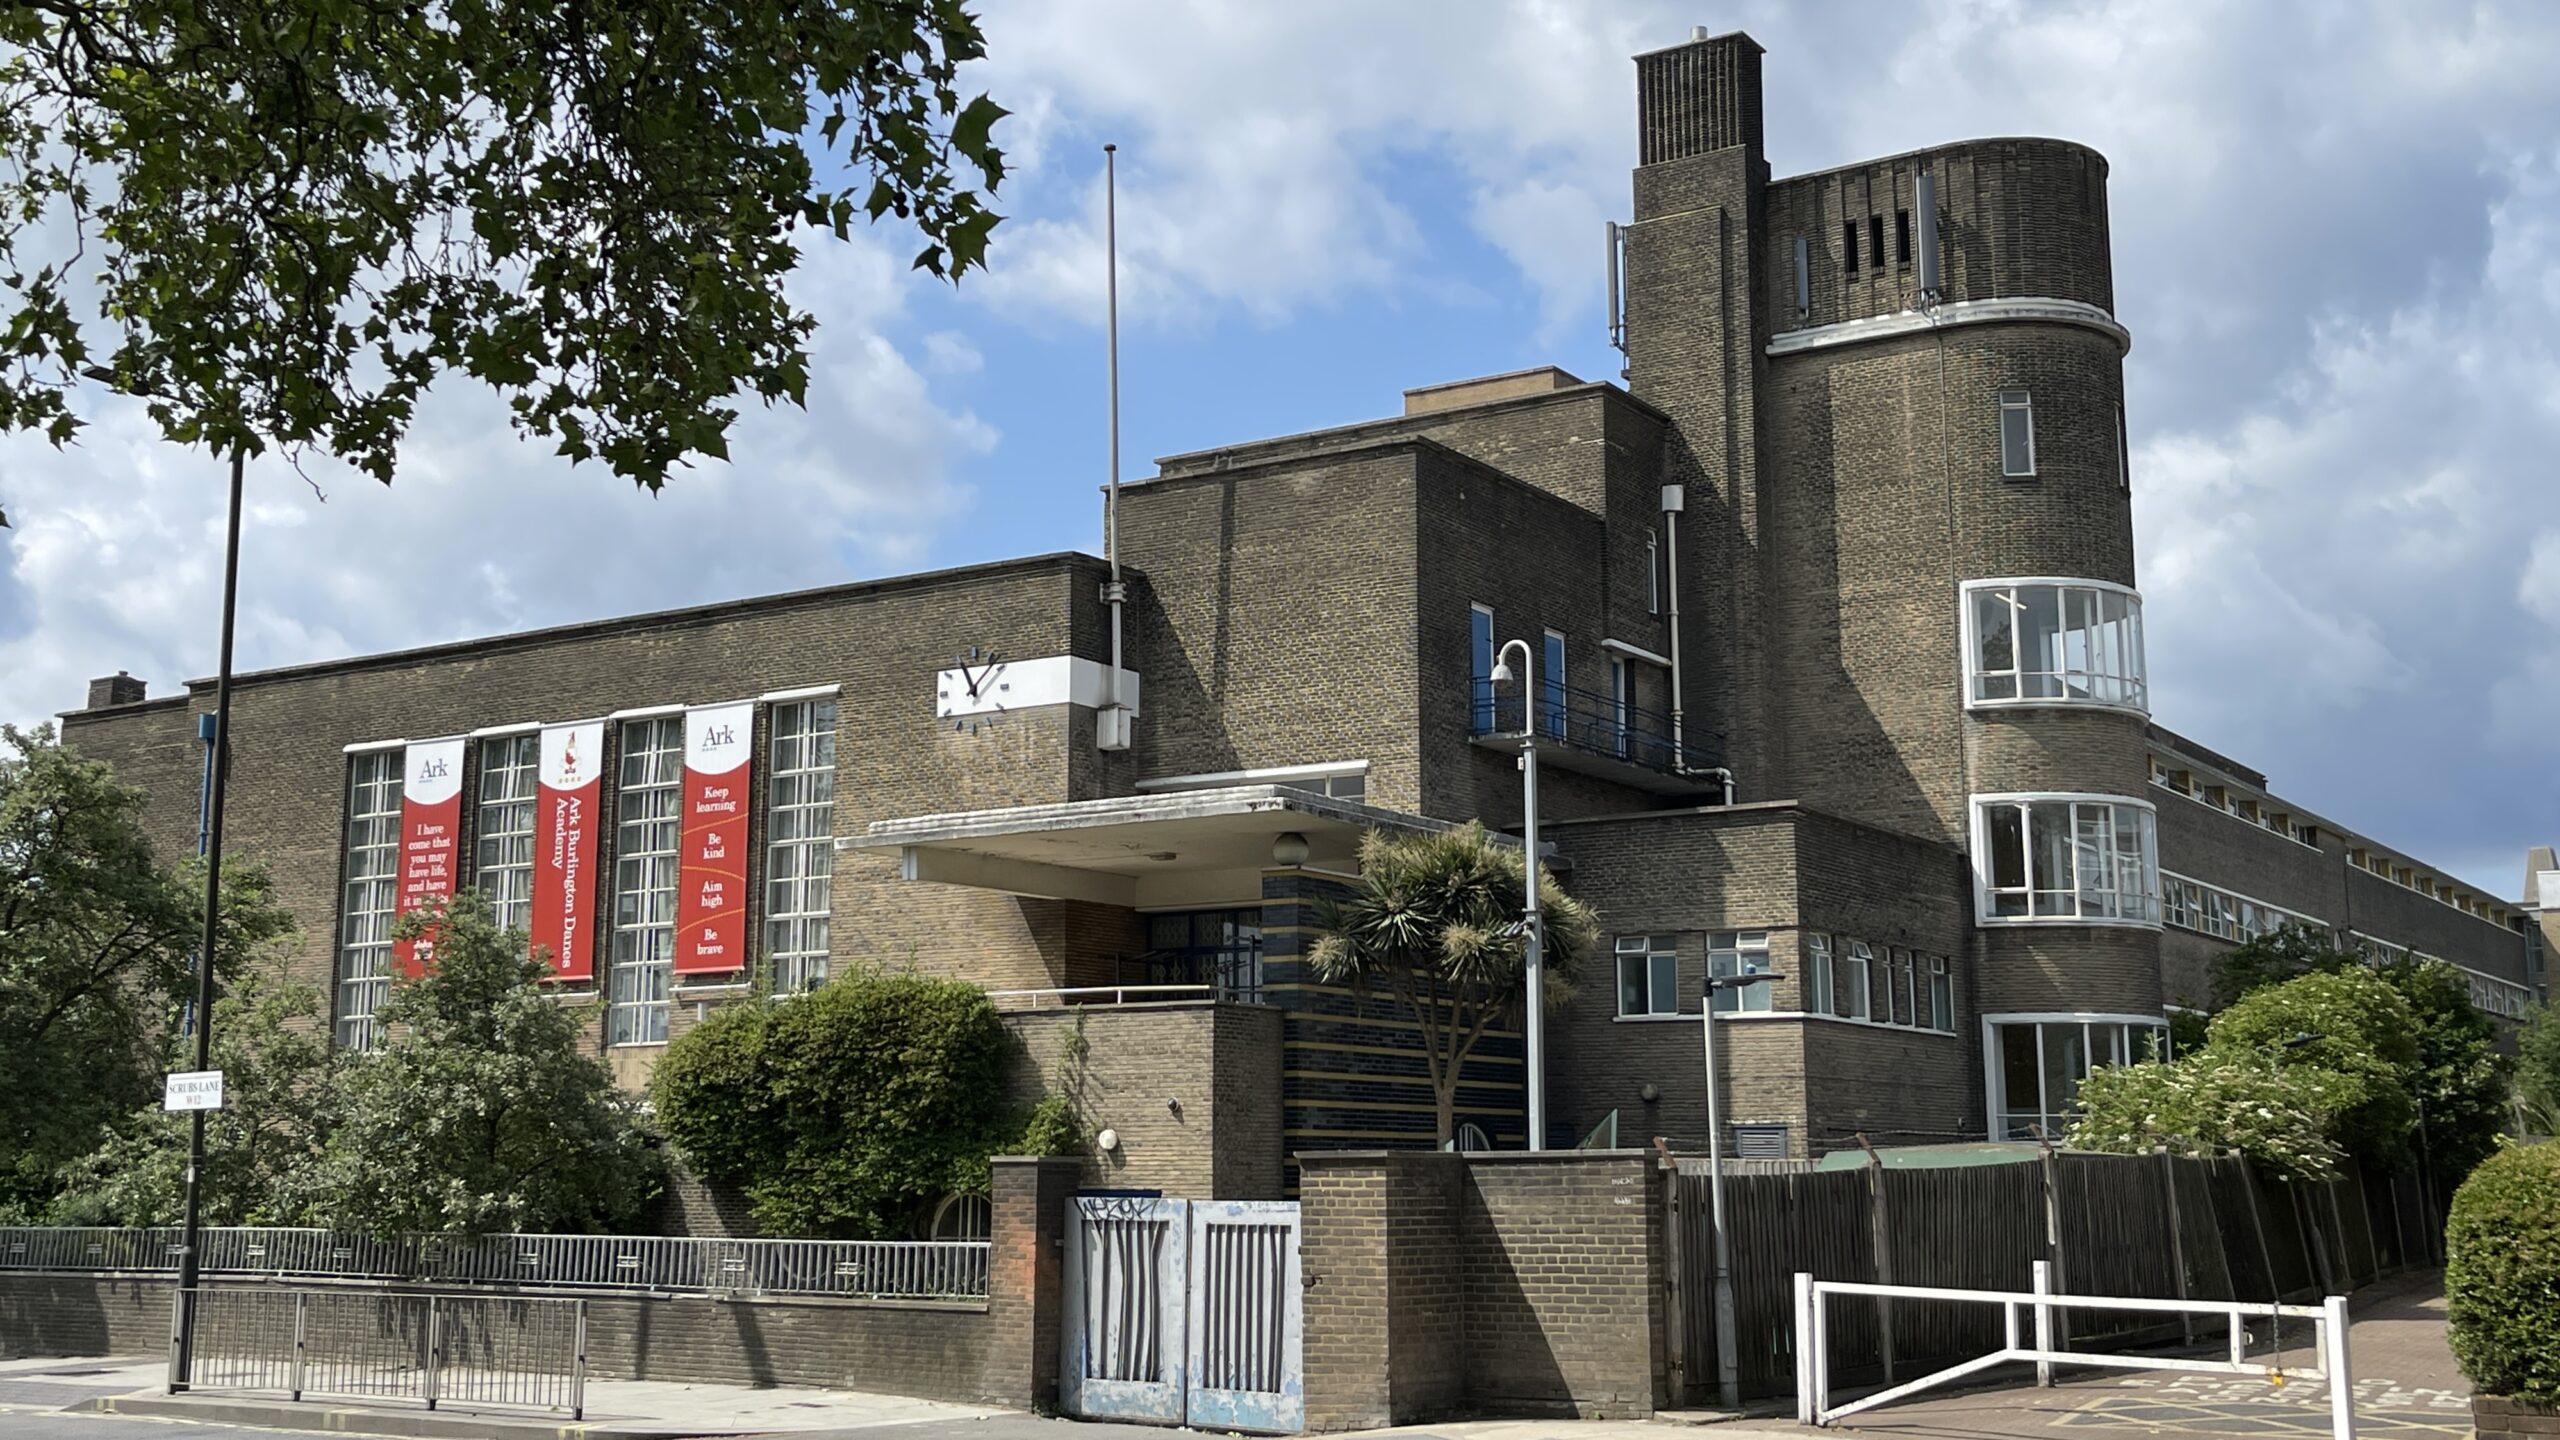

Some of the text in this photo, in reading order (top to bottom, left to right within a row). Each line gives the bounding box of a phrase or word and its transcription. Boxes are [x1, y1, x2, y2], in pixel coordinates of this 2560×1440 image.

[702, 725, 734, 747] Ark
[419, 758, 448, 778] Ark
[704, 785, 729, 799] Keep
[696, 800, 736, 813] learning
[417, 824, 444, 836] I have
[551, 798, 568, 870] Academy
[408, 837, 451, 850] come that
[708, 833, 721, 845] Be
[703, 846, 725, 860] kind
[410, 853, 448, 867] you may
[408, 867, 429, 878] have
[407, 879, 447, 892] and have
[562, 796, 582, 969] Ark Burlington Danes
[702, 880, 723, 893] Aim
[403, 895, 411, 907] it
[413, 895, 422, 906] in
[701, 894, 723, 908] high
[704, 928, 718, 941] Be
[697, 943, 724, 956] brave
[169, 1080, 220, 1094] SCRUBS LANE
[186, 1094, 202, 1105] W12
